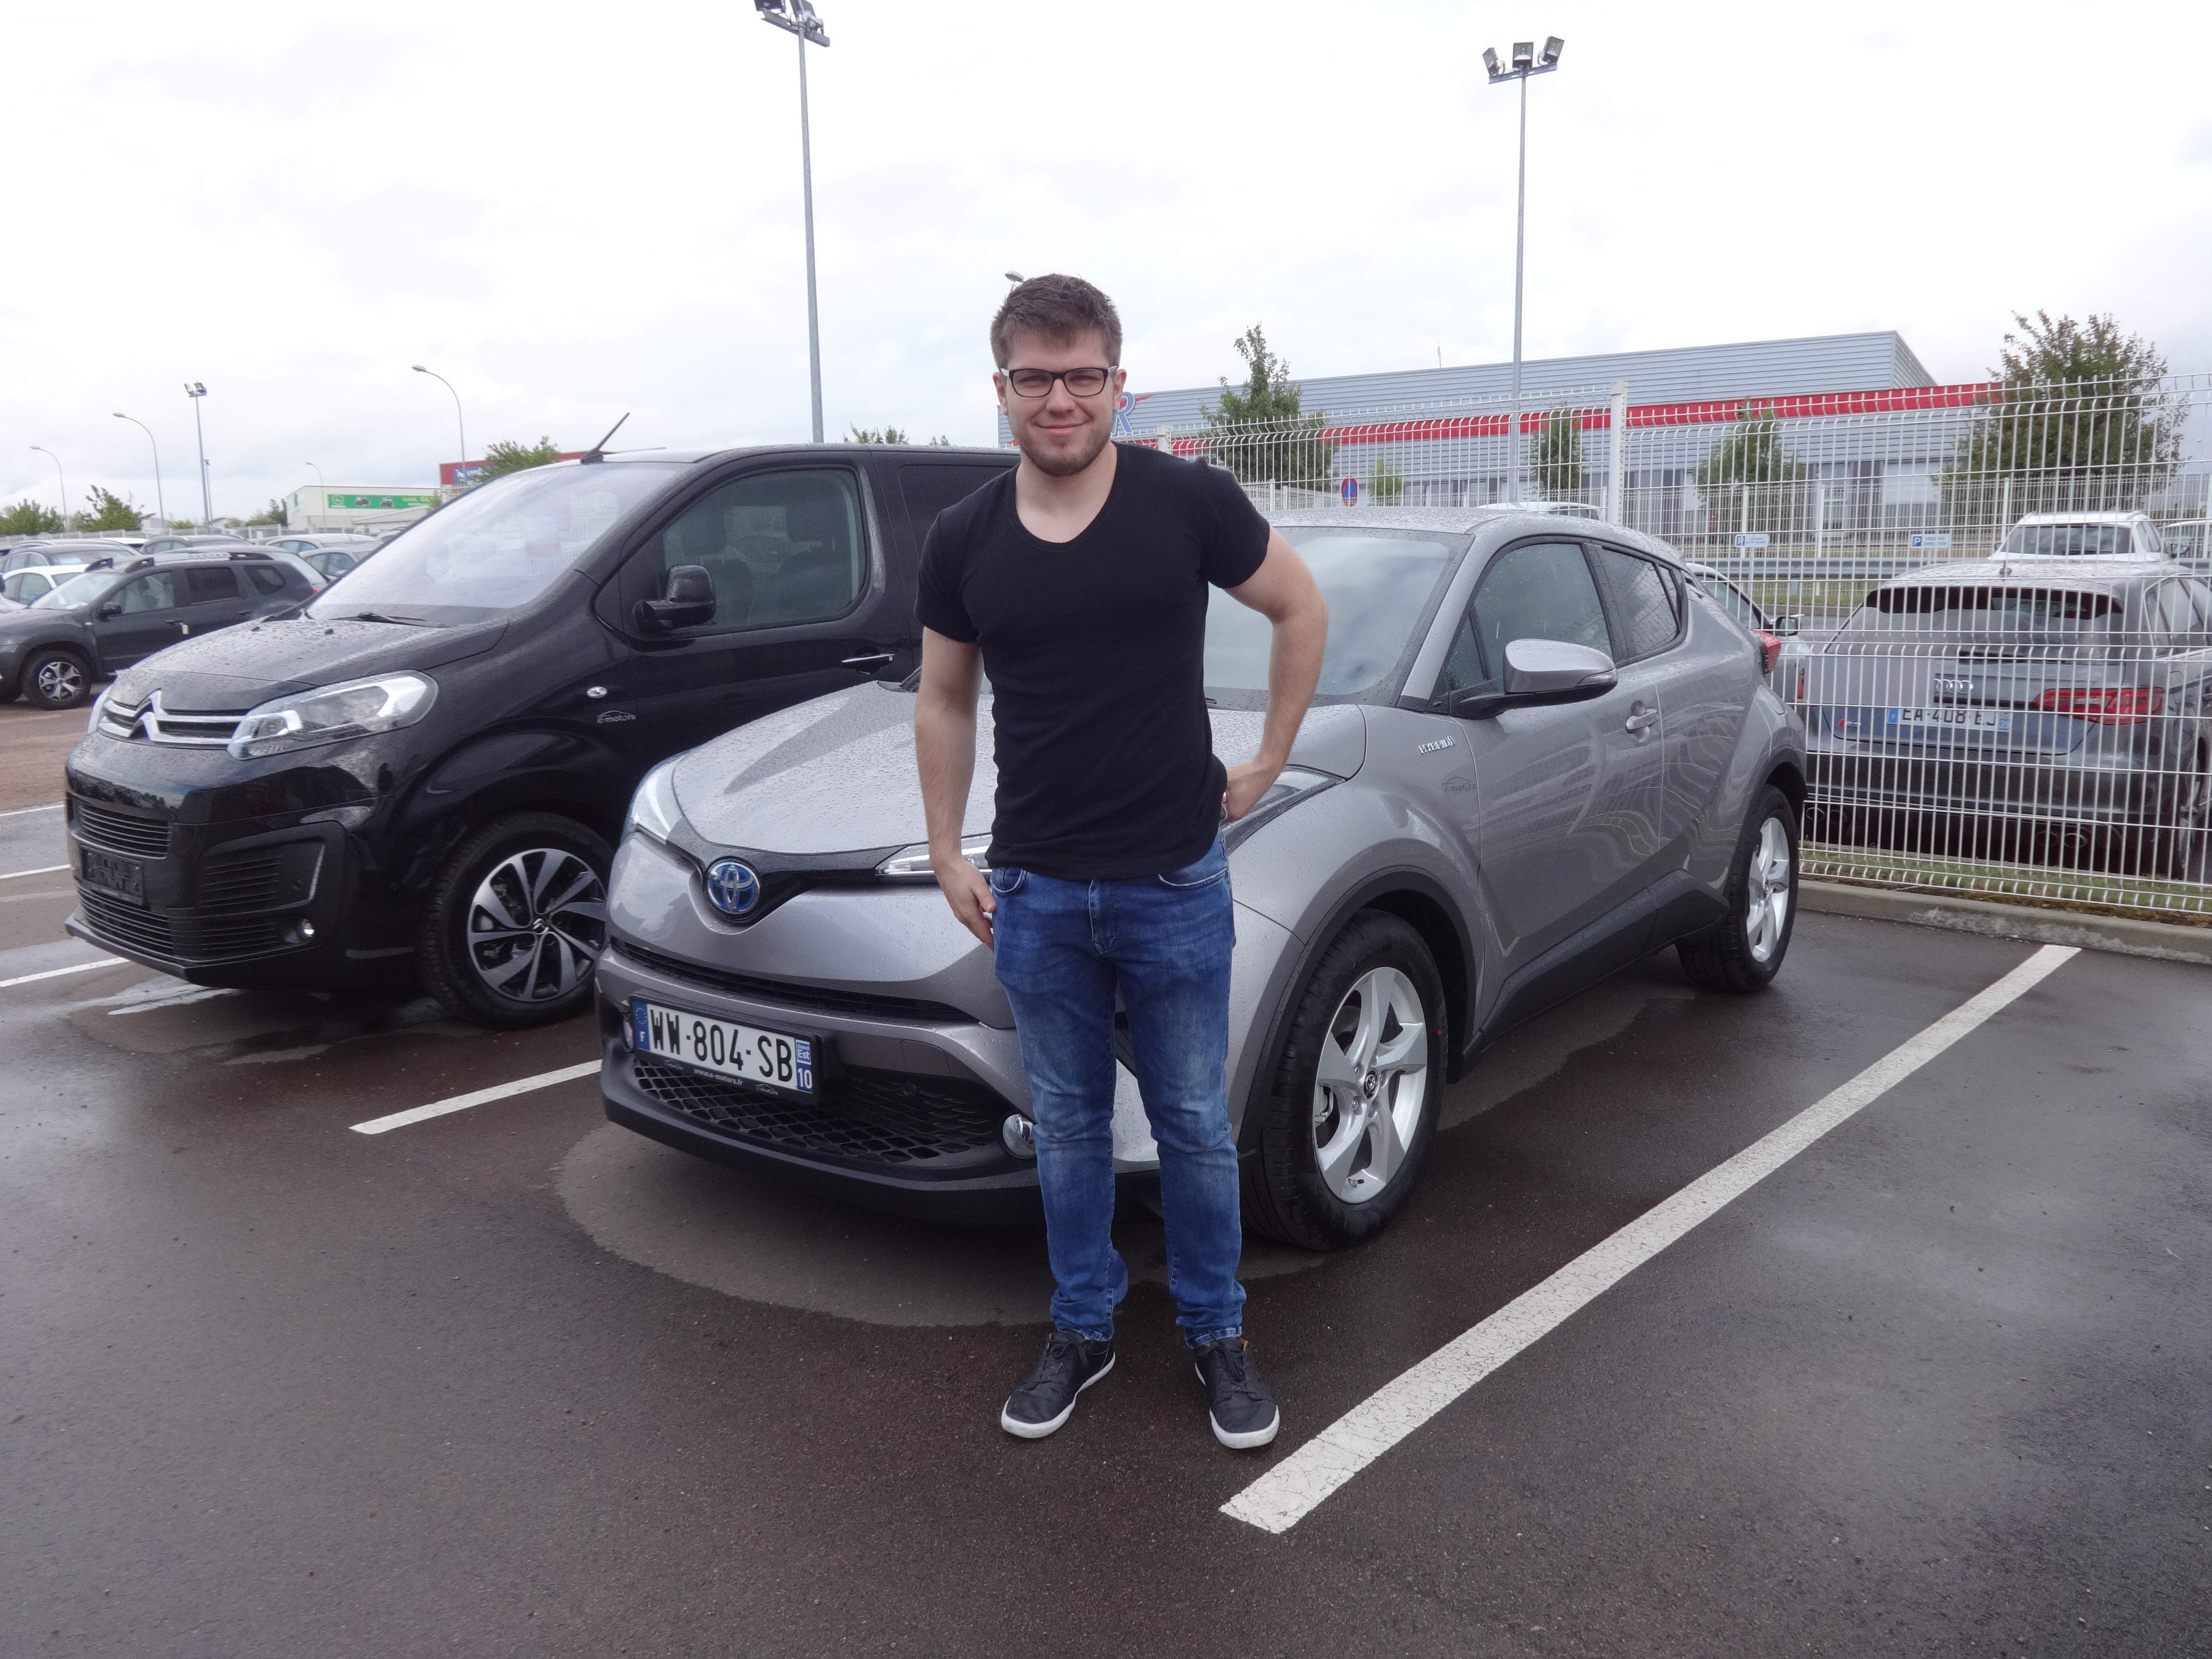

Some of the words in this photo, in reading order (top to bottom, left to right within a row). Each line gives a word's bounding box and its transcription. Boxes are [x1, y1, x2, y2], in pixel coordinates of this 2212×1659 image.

[1914, 537, 1921, 545] P
[1418, 739, 1451, 754] HYBRID
[640, 1031, 646, 1042] F
[798, 1049, 810, 1060] Est
[694, 1068, 744, 1086] www.e-motors.fr
[798, 1068, 813, 1089] 10
